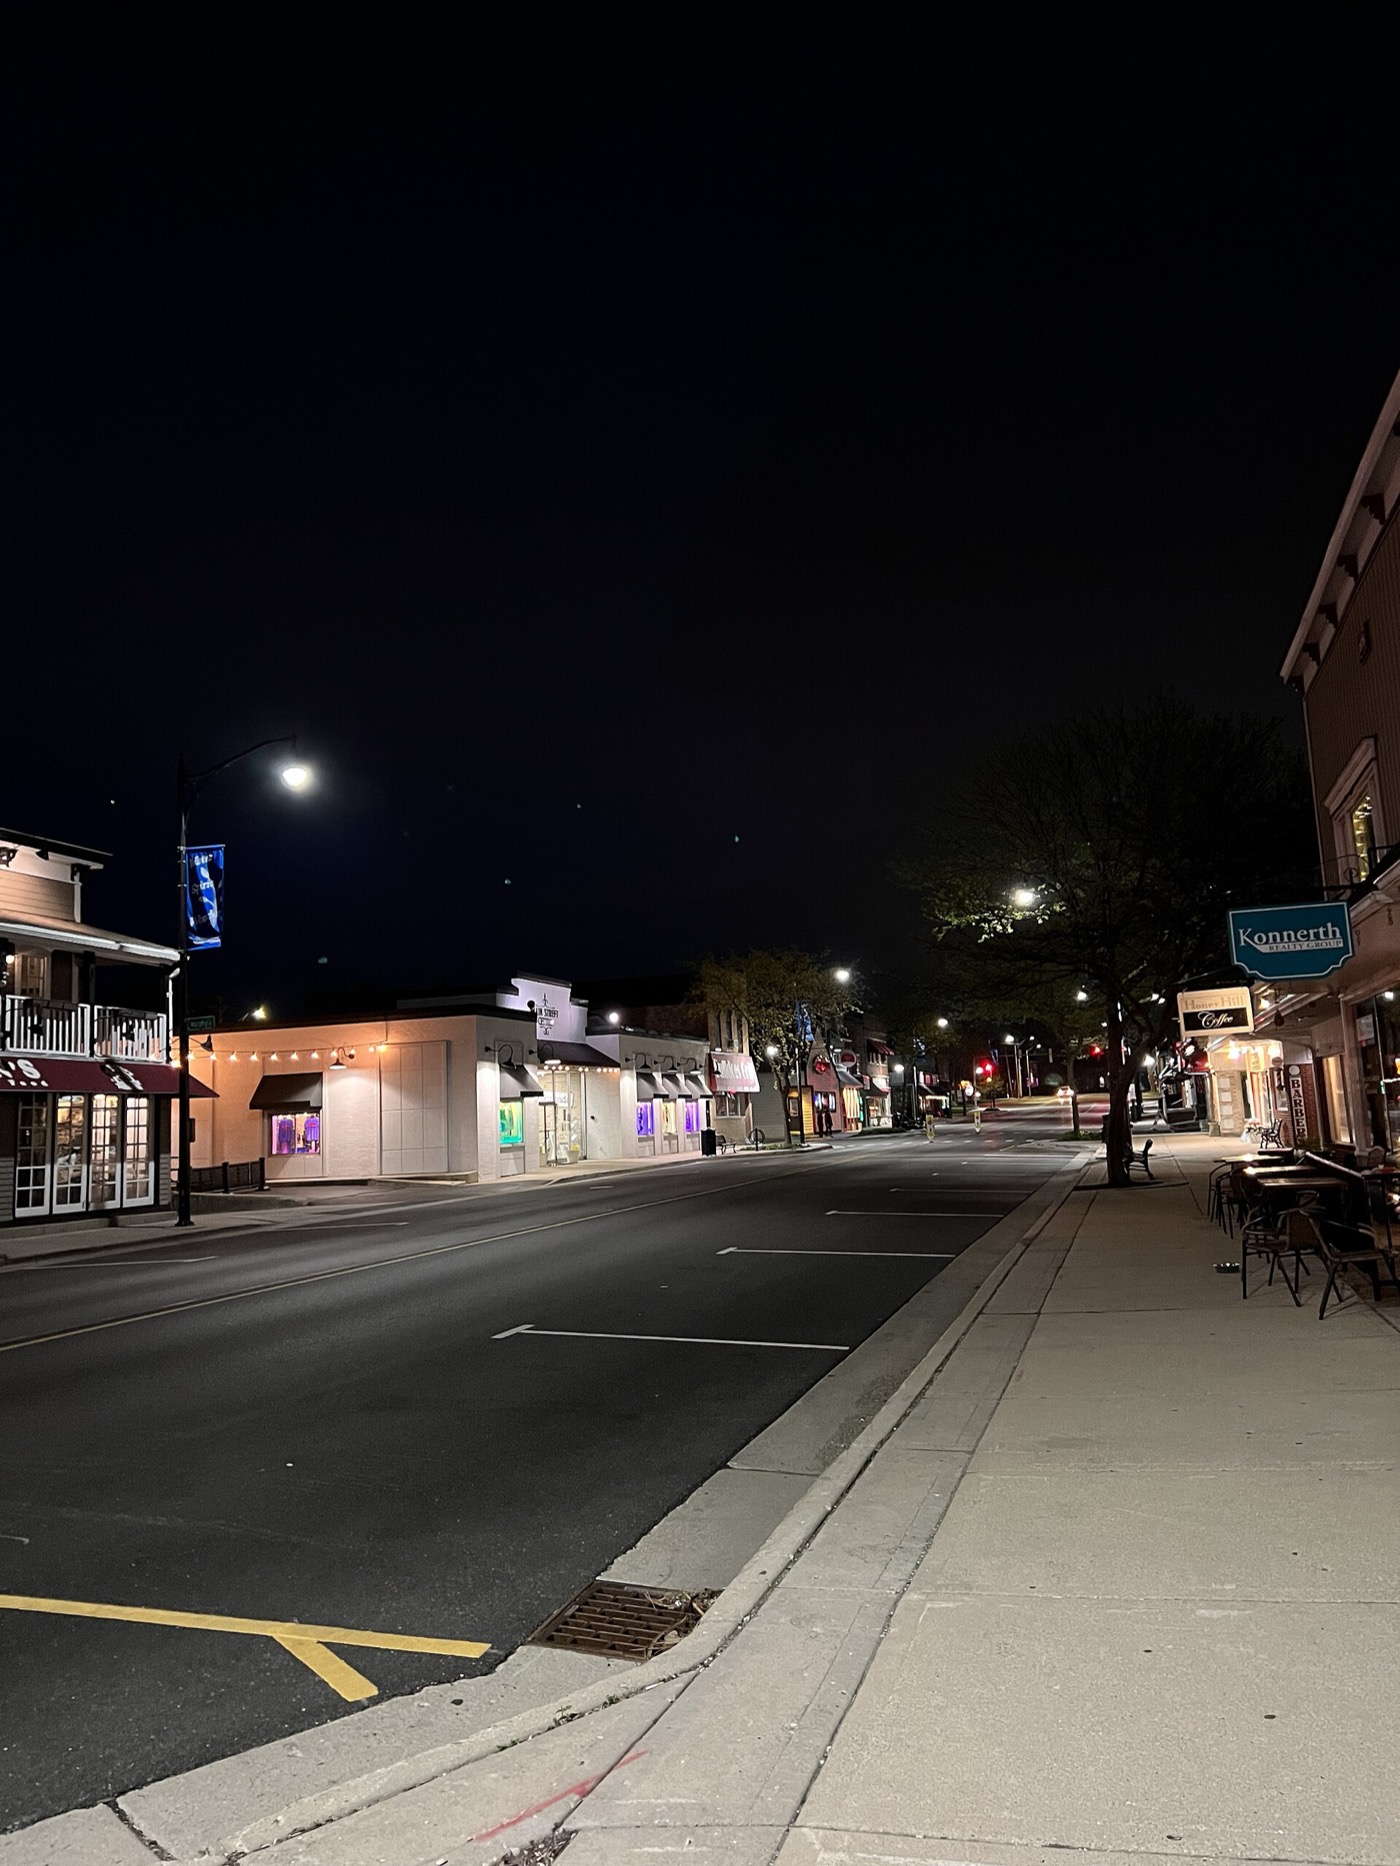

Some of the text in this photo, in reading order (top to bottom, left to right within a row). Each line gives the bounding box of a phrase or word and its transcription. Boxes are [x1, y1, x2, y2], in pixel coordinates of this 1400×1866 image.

[1238, 922, 1342, 946] Konnerth
[1269, 940, 1342, 951] REALTY GROUP
[1184, 996, 1244, 1010] Honey Hill
[1197, 1010, 1233, 1029] Coffee
